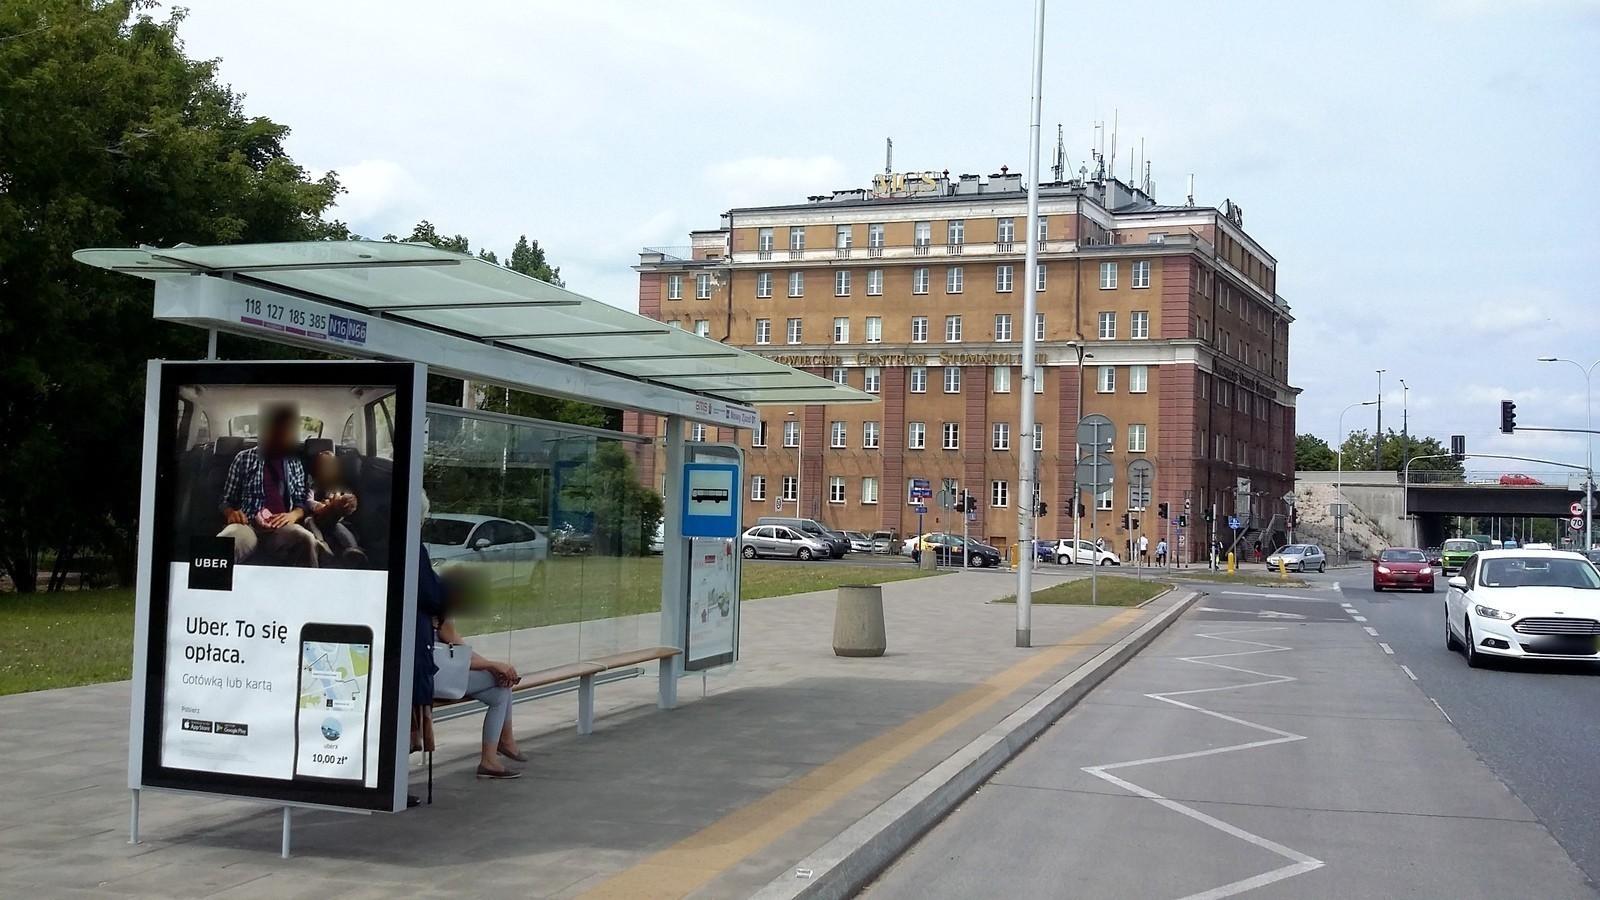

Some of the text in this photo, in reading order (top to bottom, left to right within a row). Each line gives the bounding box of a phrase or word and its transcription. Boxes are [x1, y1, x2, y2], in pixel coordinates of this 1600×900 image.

[245, 298, 262, 315] 118
[267, 303, 285, 320] 127
[289, 308, 306, 326] 185
[309, 313, 327, 330] 385
[329, 318, 347, 337] N16
[348, 322, 367, 340] N66
[1572, 519, 1583, 527] 70
[195, 558, 228, 569] UBER
[186, 617, 288, 644] Uber. To się
[185, 643, 245, 664] opłaca.
[182, 673, 272, 692] Gotówką lub kartą
[312, 753, 336, 765] 10,00
